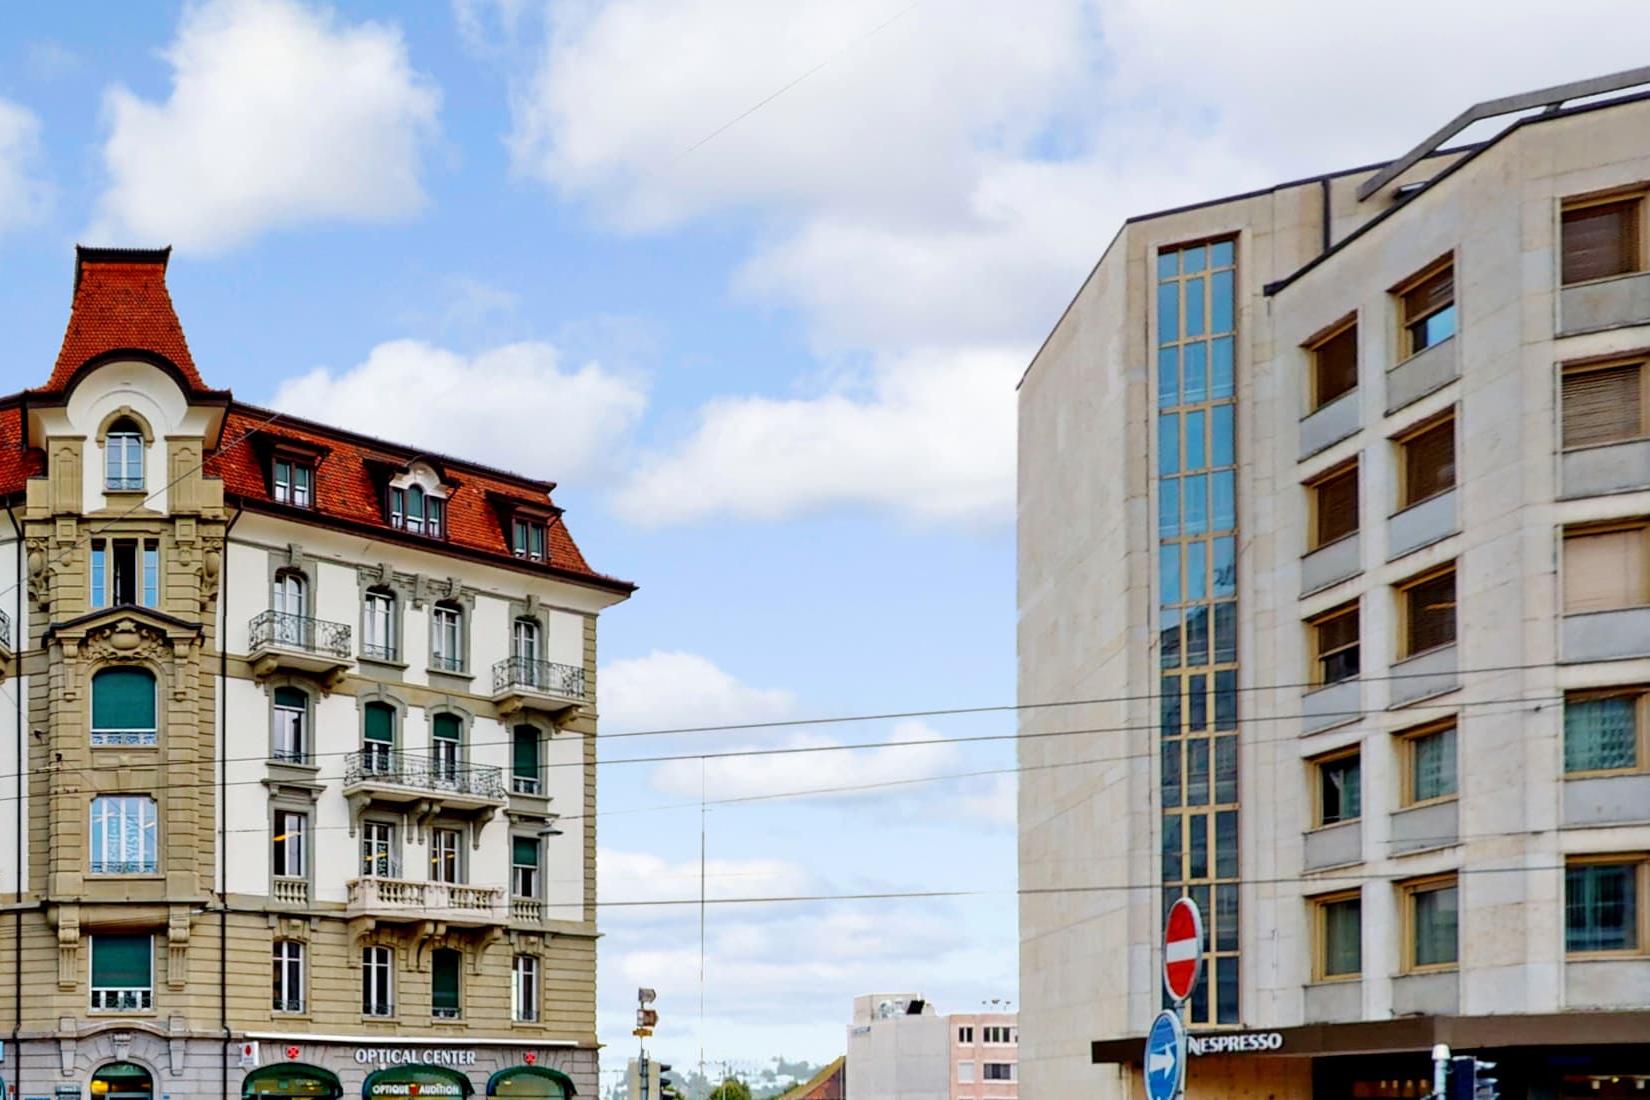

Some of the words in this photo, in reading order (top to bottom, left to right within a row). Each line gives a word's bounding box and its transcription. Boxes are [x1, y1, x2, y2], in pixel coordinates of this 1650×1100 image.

[1187, 1033, 1283, 1055] NESPRESSO
[355, 1048, 419, 1064] OPTICAL
[422, 1049, 476, 1065] CENTER
[372, 1084, 409, 1095] OPTIQUE
[418, 1083, 459, 1096] AUDITION
